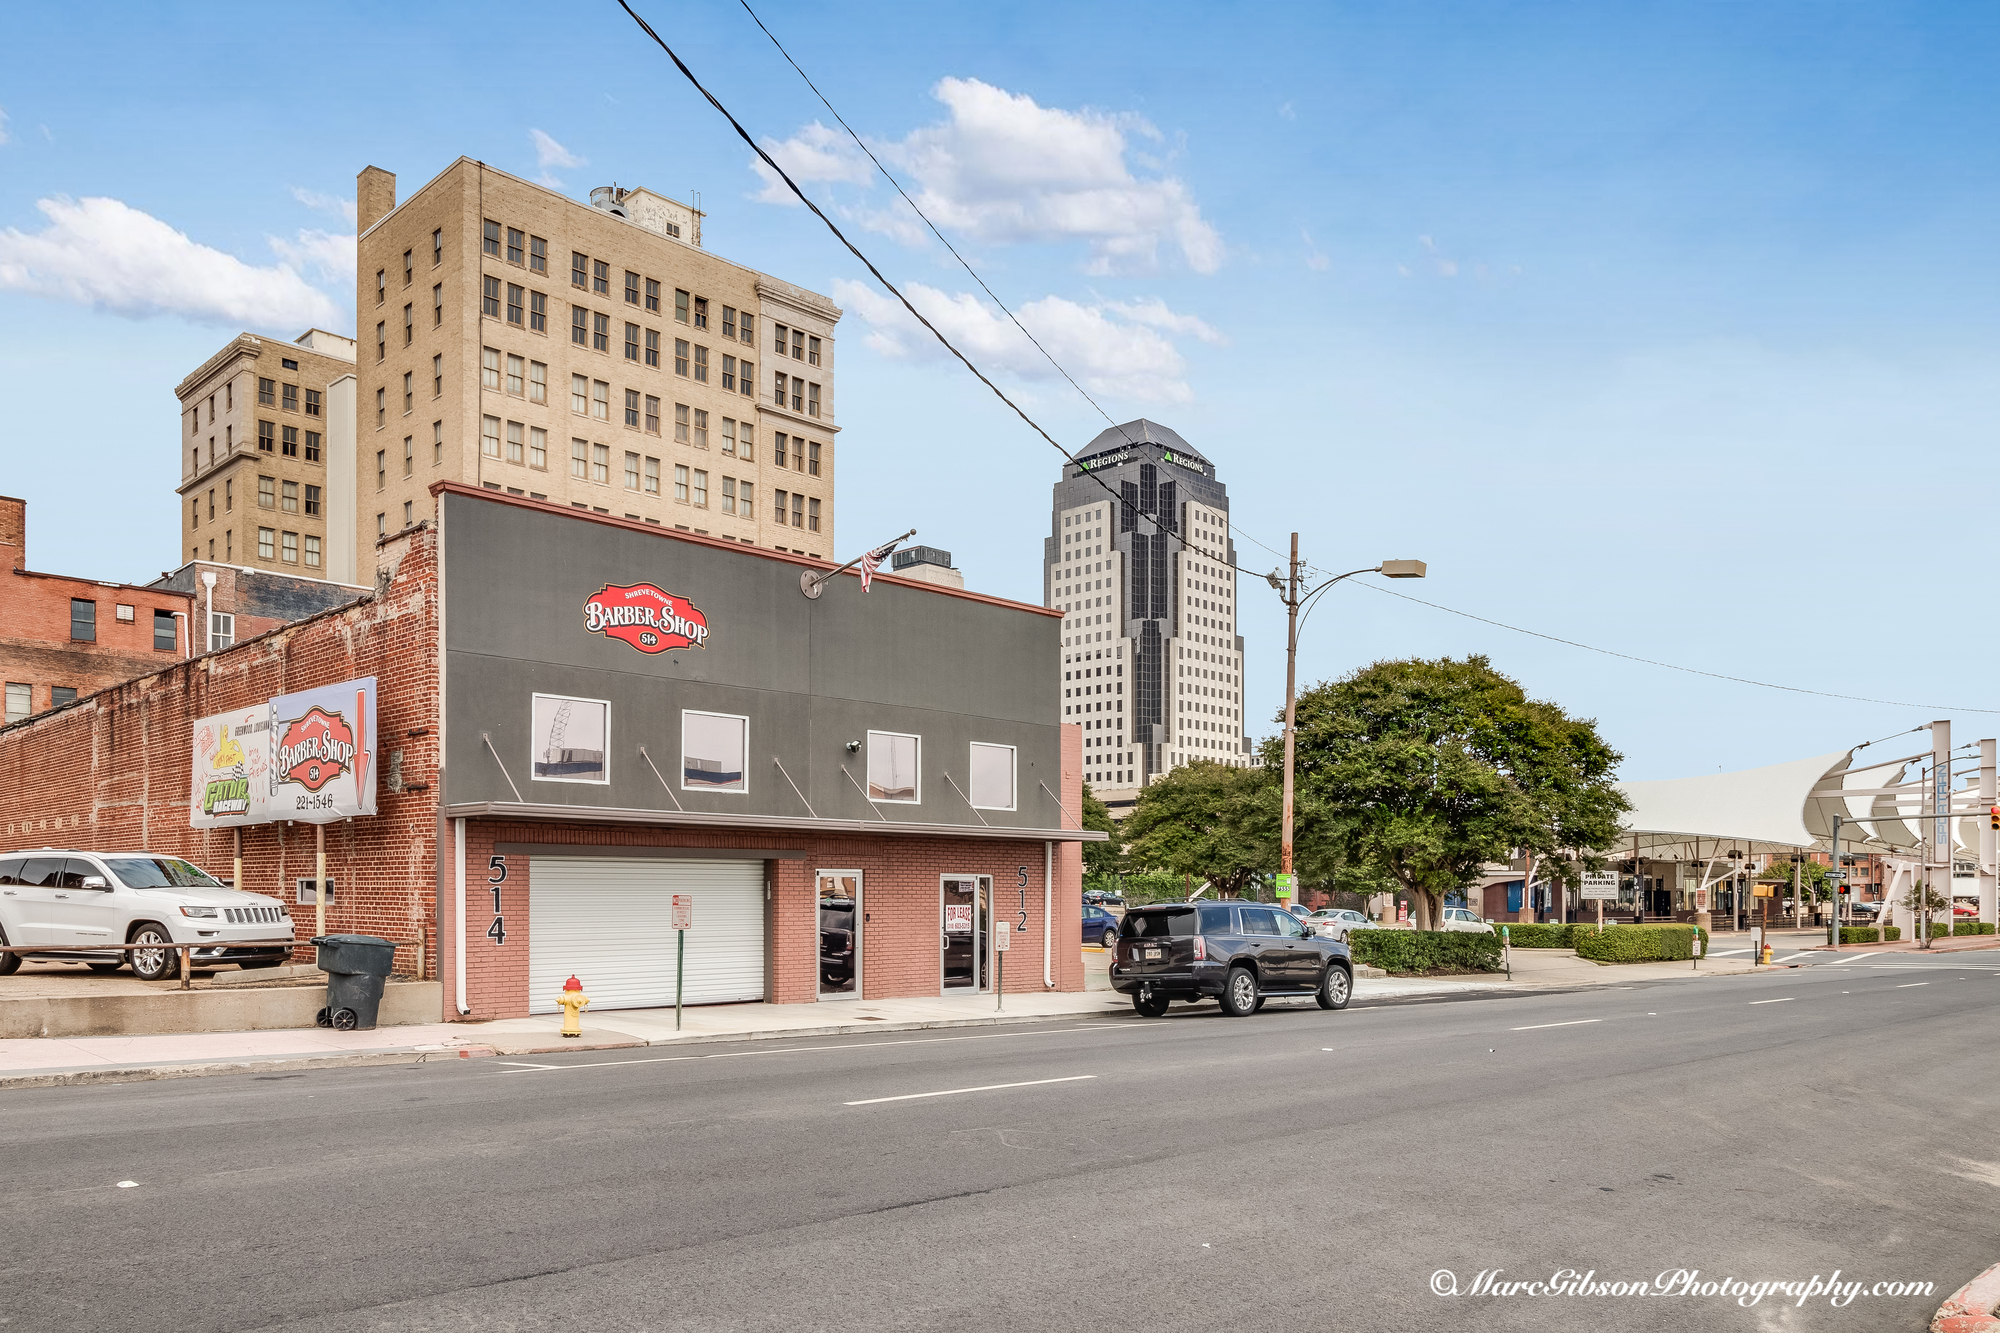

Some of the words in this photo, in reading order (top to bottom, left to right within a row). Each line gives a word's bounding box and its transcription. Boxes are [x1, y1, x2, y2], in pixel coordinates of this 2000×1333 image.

[1090, 452, 1129, 468] REGIONS
[1173, 454, 1203, 472] REGIONS
[625, 589, 673, 606] SHREVETOWNE
[585, 602, 659, 632] BARBER
[659, 606, 709, 644] SHOP
[641, 633, 657, 644] 514
[300, 715, 330, 733] SHREVETOWNE
[280, 737, 321, 777] BARBER
[320, 730, 354, 767] SHOP
[309, 767, 320, 779] 514
[213, 799, 248, 813] RACEWAY
[1937, 765, 1947, 844] SPORTRAN
[487, 855, 508, 945] 514
[1016, 866, 1029, 932] 512
[948, 907, 956, 921] FOR
[957, 907, 971, 921] LEASE
